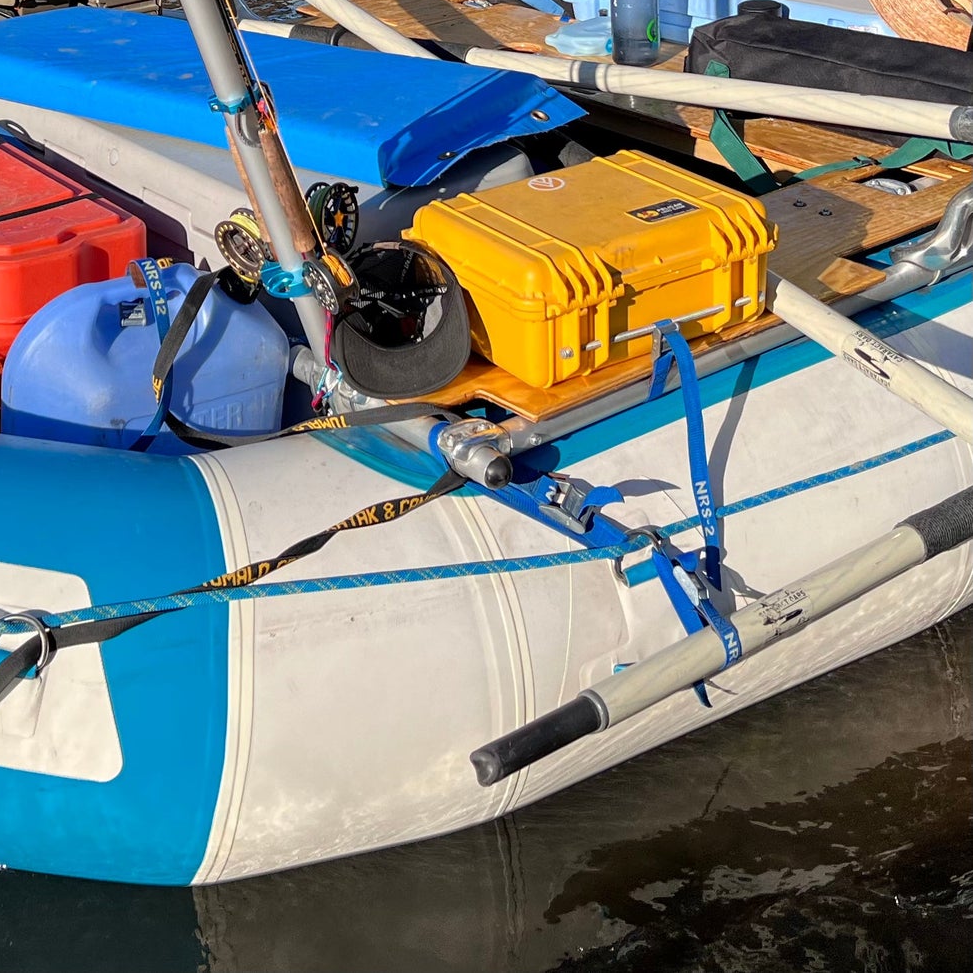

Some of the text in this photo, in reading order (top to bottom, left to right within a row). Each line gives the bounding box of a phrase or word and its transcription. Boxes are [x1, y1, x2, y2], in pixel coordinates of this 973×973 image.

[140, 259, 167, 316] NRS-12
[383, 502, 396, 520] &
[694, 480, 716, 538] NRS-2
